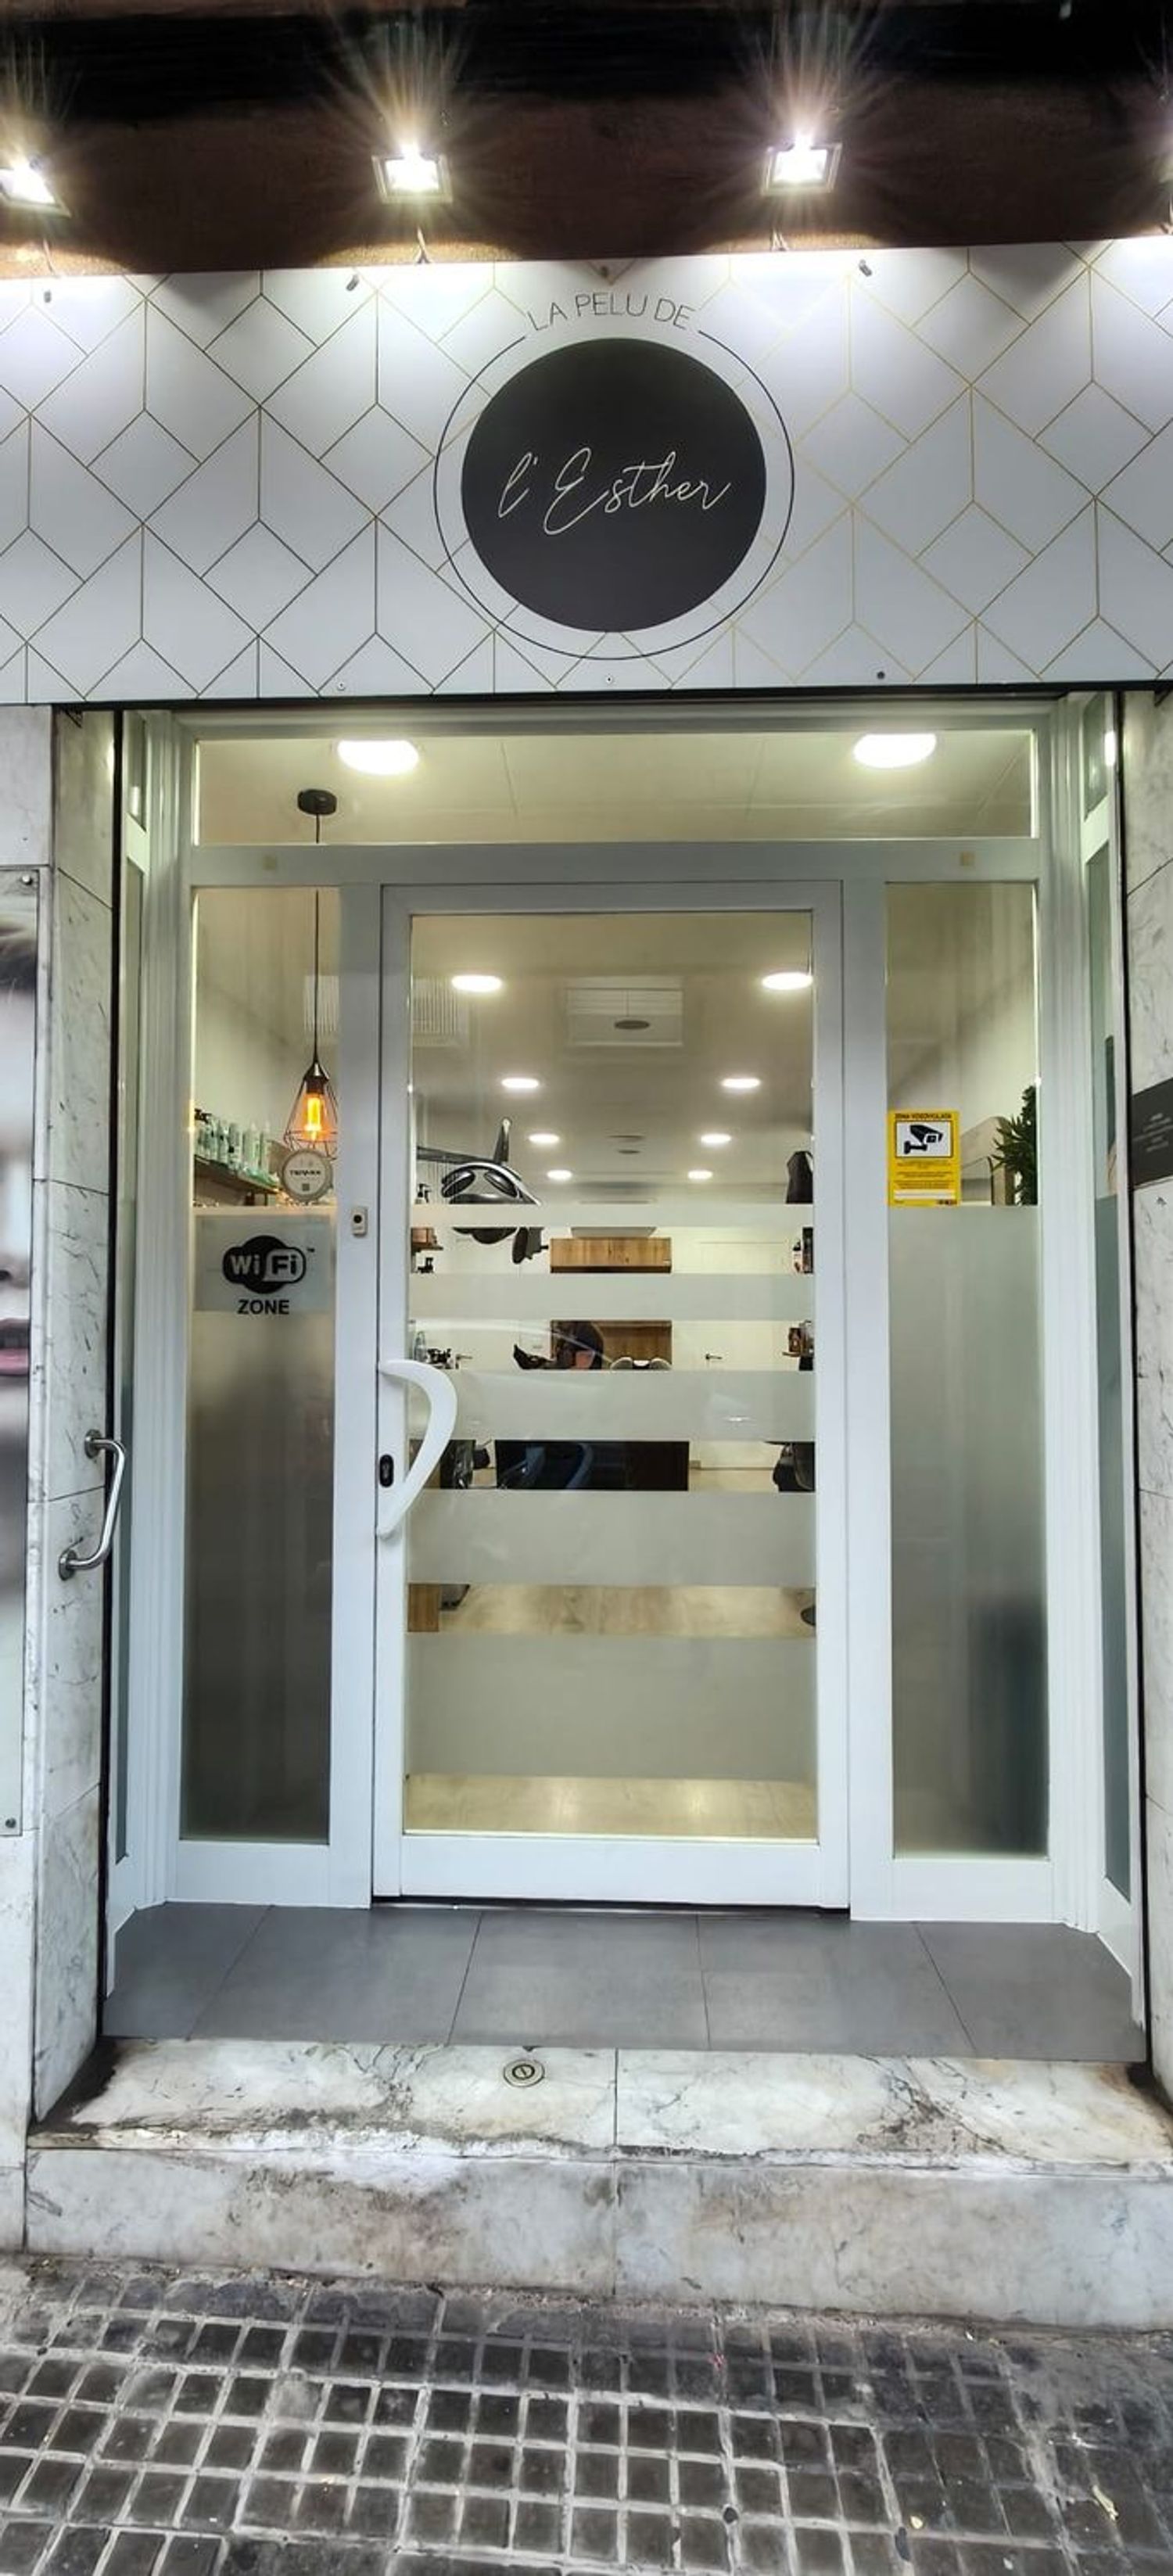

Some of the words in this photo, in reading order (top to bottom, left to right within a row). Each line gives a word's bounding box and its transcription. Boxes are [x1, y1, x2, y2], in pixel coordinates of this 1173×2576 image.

[527, 302, 569, 331] LA
[575, 292, 648, 318] PELU
[654, 298, 695, 330] DE
[543, 447, 731, 536] Esther
[237, 1299, 290, 1315] ZONE
